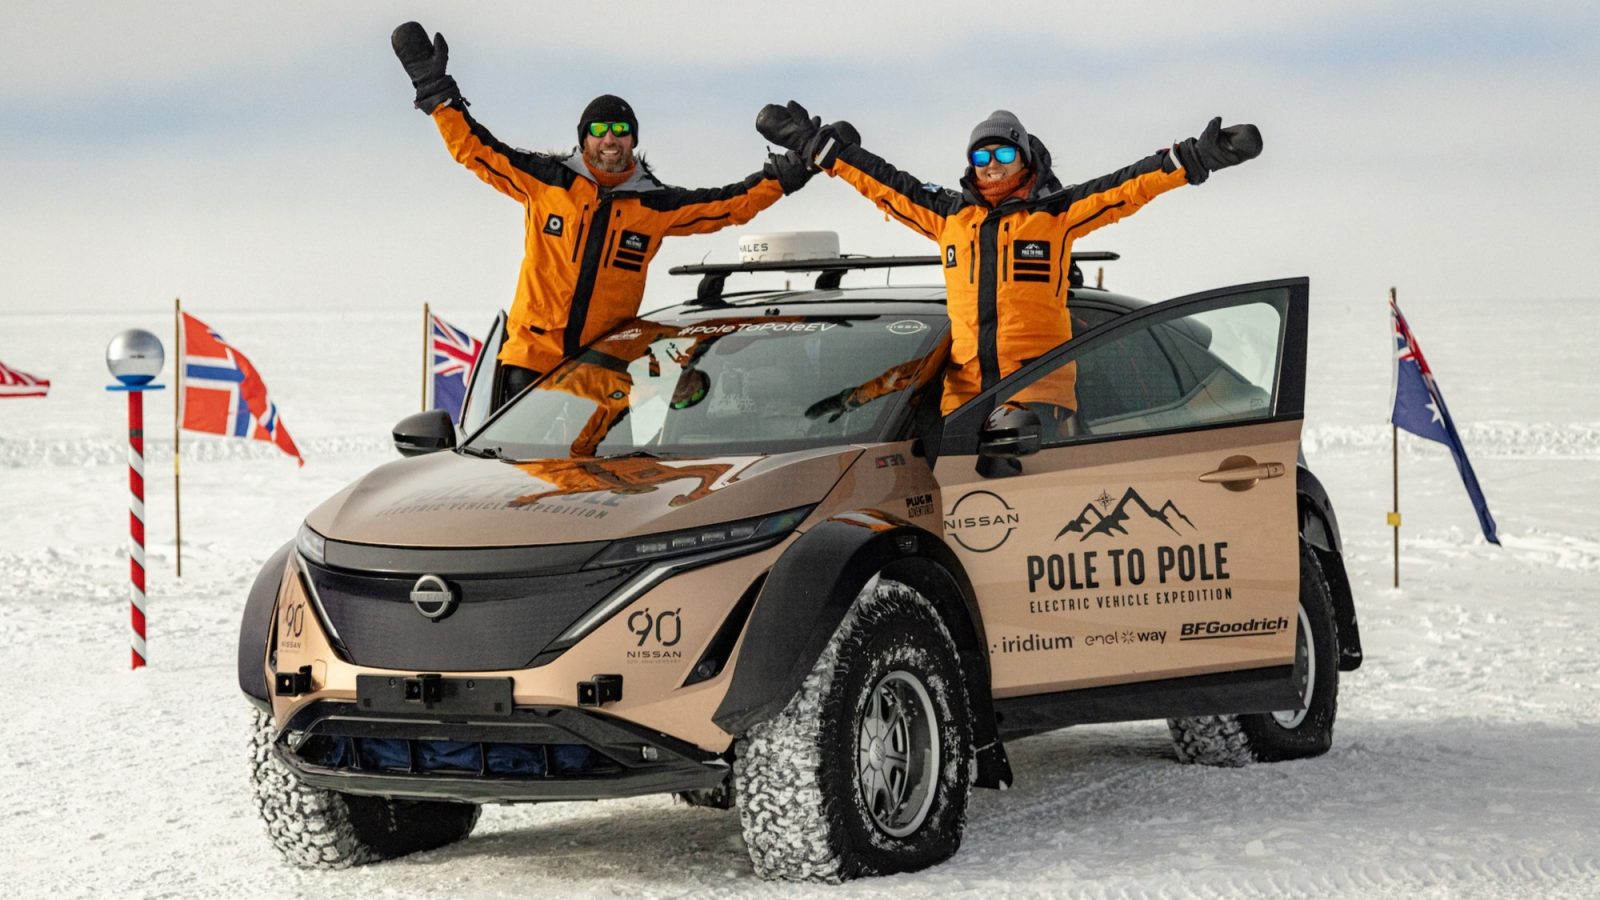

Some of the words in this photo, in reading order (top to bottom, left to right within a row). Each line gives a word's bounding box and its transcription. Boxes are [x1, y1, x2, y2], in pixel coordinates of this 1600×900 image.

[905, 495, 925, 508] PLUG
[943, 513, 1020, 530] NISSAN
[1027, 551, 1099, 592] POLE
[1107, 548, 1145, 586] TO
[1157, 542, 1230, 584] POLE
[1029, 597, 1090, 613] ELECTRIC
[1096, 593, 1149, 608] VEHICLE
[1156, 587, 1232, 604] EXPEDITION
[627, 607, 681, 647] 90
[1180, 616, 1289, 636] BFGoodrich
[1002, 634, 1073, 653] iridium
[1084, 631, 1119, 646] enel
[1137, 631, 1167, 644] way
